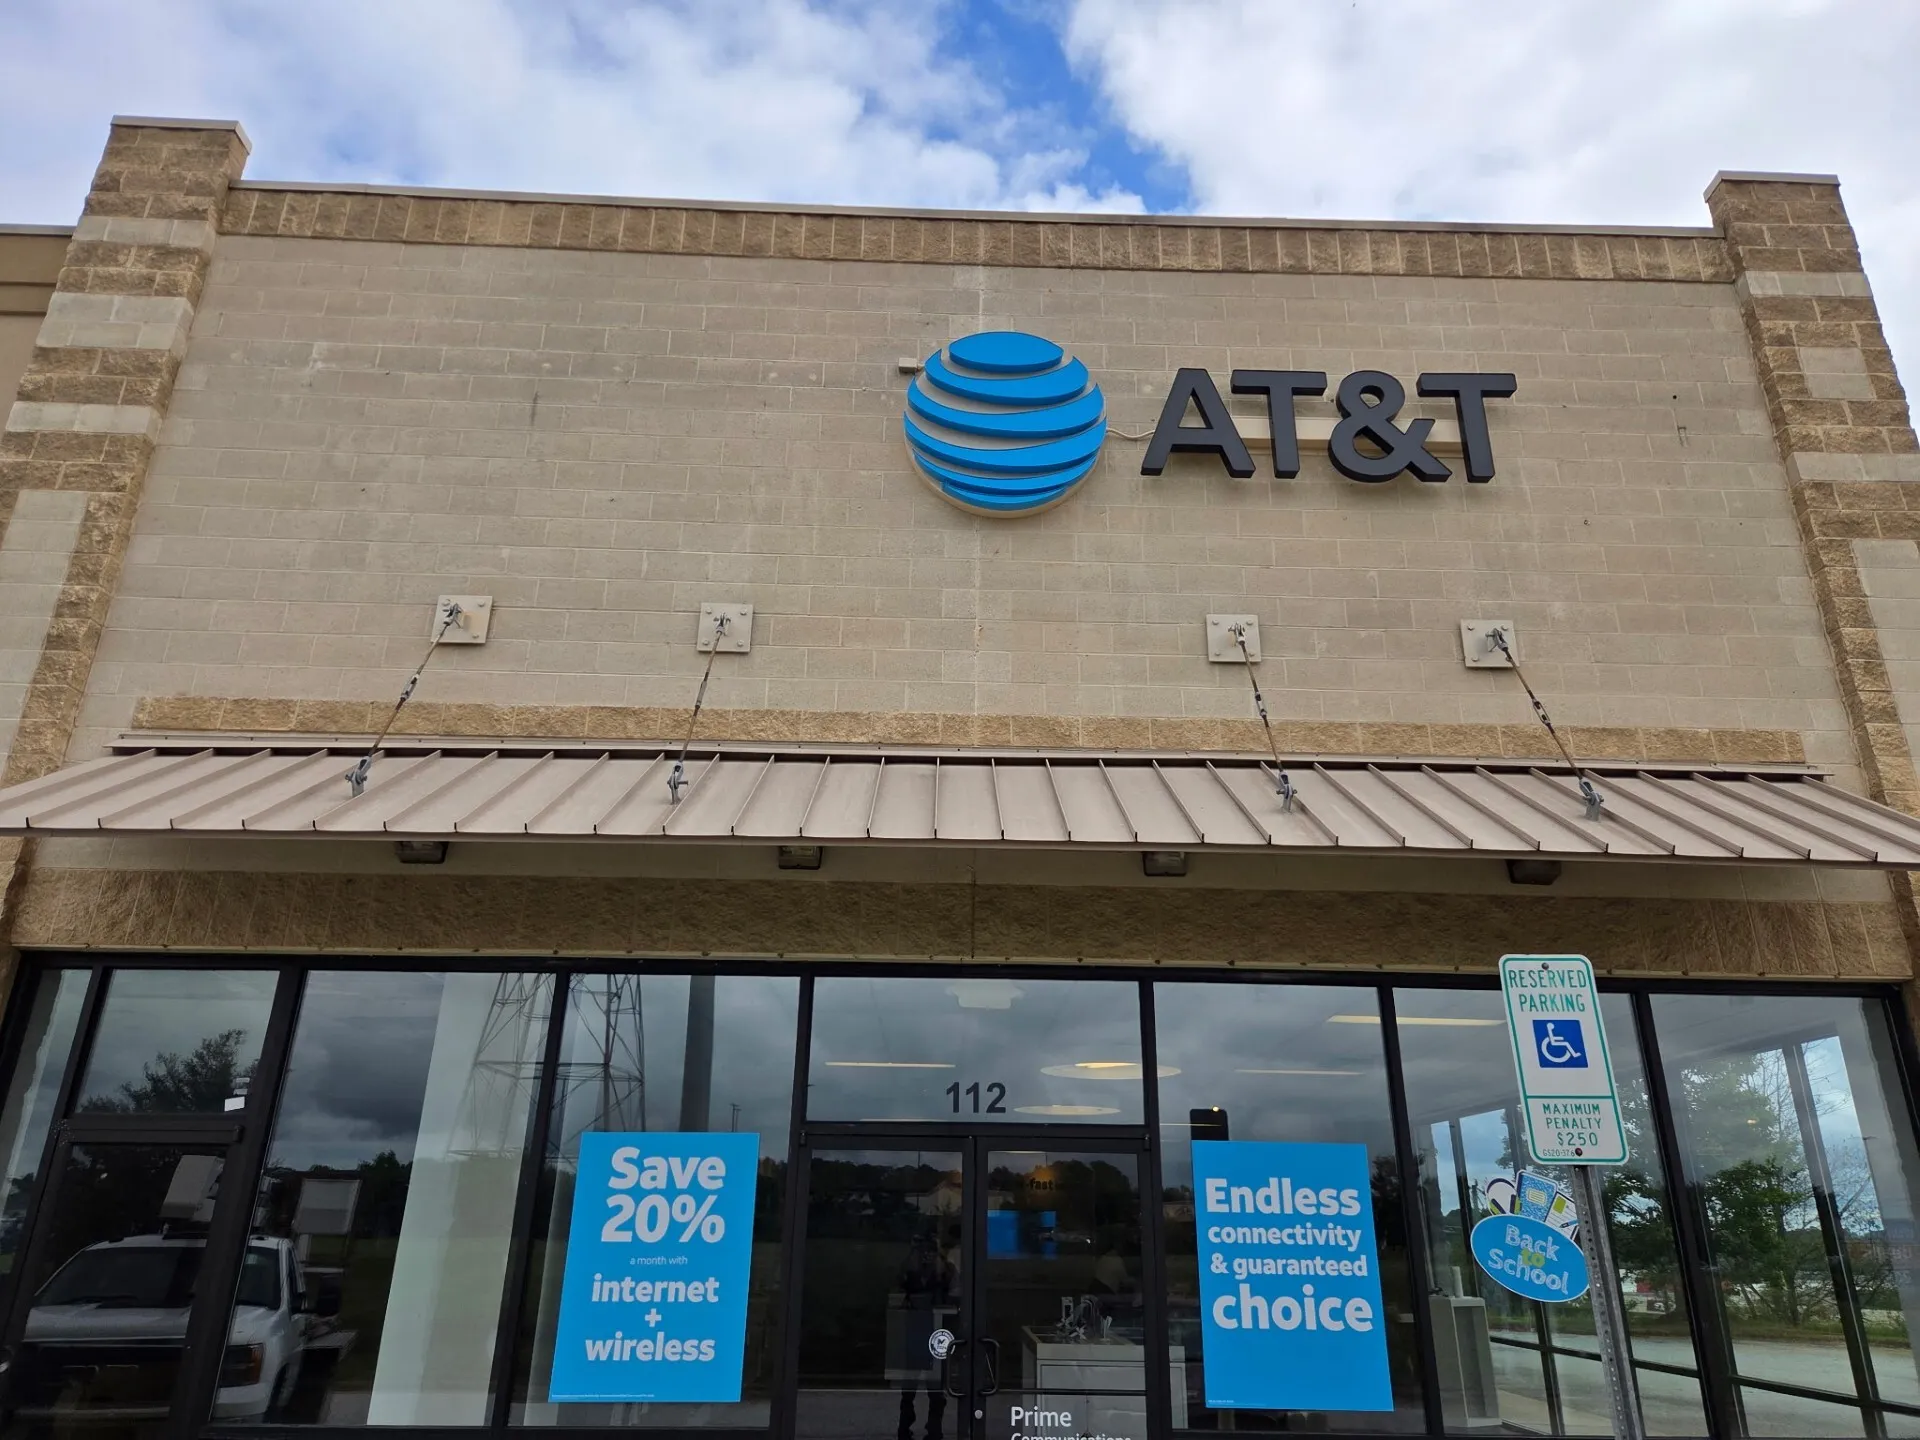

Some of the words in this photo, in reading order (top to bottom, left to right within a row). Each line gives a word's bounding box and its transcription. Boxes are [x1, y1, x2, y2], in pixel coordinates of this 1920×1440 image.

[1140, 368, 1517, 484] AT&T
[1508, 969, 1587, 988] RESERVED
[1518, 993, 1586, 1013] PARKING
[946, 1082, 1006, 1113] 112
[1542, 1103, 1600, 1115] MAXIMUM
[1545, 1117, 1602, 1129] PENALTY
[1557, 1132, 1598, 1146] $250
[607, 1146, 726, 1190] Save
[1205, 1177, 1361, 1216] Endless
[601, 1194, 726, 1243] 20%
[1208, 1222, 1361, 1252] connectivity
[1505, 1224, 1560, 1261] Back
[630, 1257, 636, 1265] a
[637, 1256, 667, 1265] month
[668, 1255, 688, 1265] with
[1211, 1253, 1229, 1274] &
[1234, 1254, 1368, 1280] guaranteed
[1488, 1248, 1569, 1295] School
[1521, 1248, 1545, 1267] to
[591, 1273, 719, 1303] internet
[1212, 1283, 1373, 1332] choice
[585, 1331, 716, 1362] wireless
[1011, 1405, 1072, 1427] Prime
